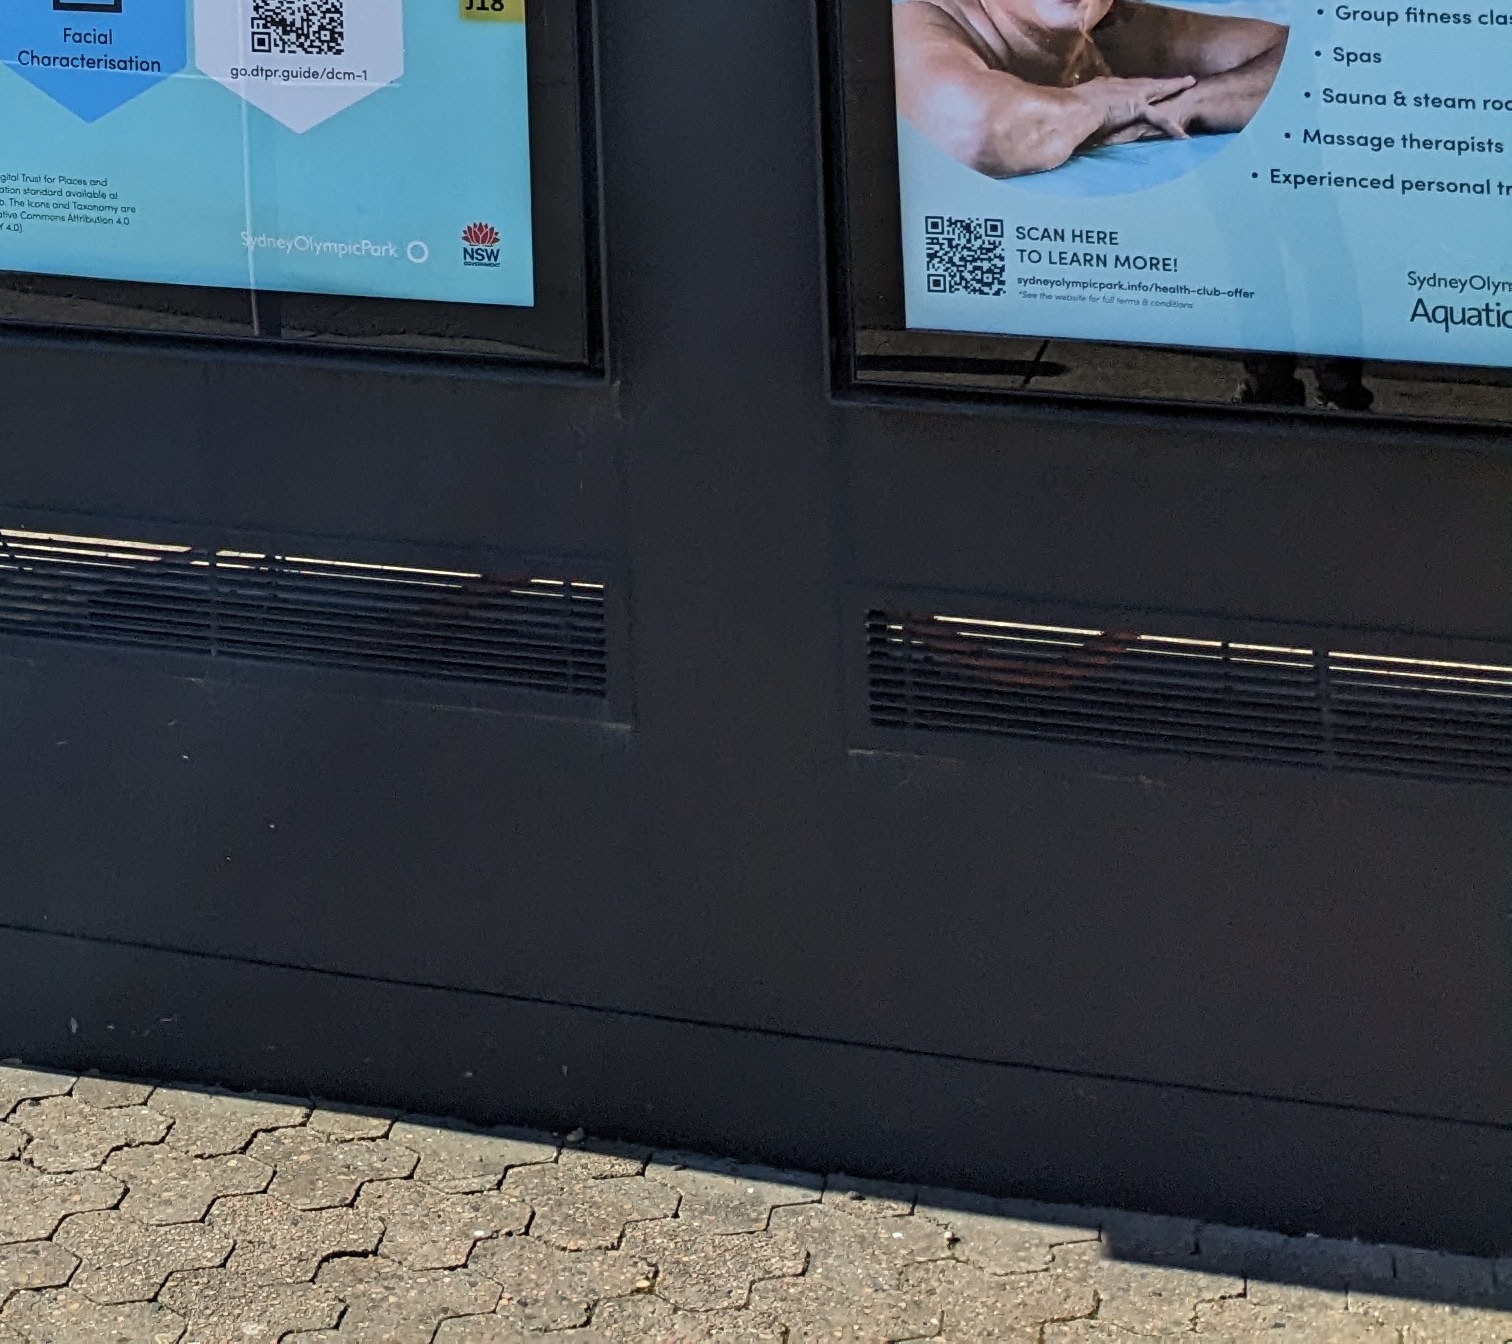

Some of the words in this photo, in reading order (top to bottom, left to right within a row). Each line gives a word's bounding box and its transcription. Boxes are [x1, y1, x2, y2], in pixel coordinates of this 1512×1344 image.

[1336, 5, 1399, 26] Group
[1405, 7, 1472, 24] fitness
[64, 27, 112, 45] Facial
[18, 50, 161, 72] Characterisation
[1333, 47, 1382, 67] Spas
[230, 65, 367, 81] go.dtpr.guide/dcm-1
[1323, 88, 1386, 105] Sauna
[1393, 91, 1407, 106] &
[1413, 93, 1476, 109] steam
[1483, 99, 1512, 111] roo
[1303, 129, 1395, 152] Massage
[1401, 133, 1504, 156] therapists
[44, 174, 56, 184] for
[58, 175, 87, 186] Places
[89, 178, 107, 187] and
[1270, 169, 1394, 189] Experienced
[1401, 179, 1490, 195] personal
[1497, 181, 1512, 196] tr
[65, 190, 107, 199] available
[9, 198, 25, 207] The
[52, 201, 70, 209] and
[72, 201, 118, 214] Taxonomy
[20, 211, 65, 222] Commons
[67, 214, 114, 224] Attribution
[116, 217, 130, 225] 4.0
[240, 230, 399, 258] SydneyOlympicPark
[1016, 226, 1065, 242] SCAN
[1072, 229, 1119, 245] HERE
[463, 247, 500, 262] NSW
[1016, 249, 1042, 263] TO
[1049, 251, 1107, 268] LEARN
[1114, 255, 1177, 272] MORE!
[1410, 298, 1512, 333] Aquatic
